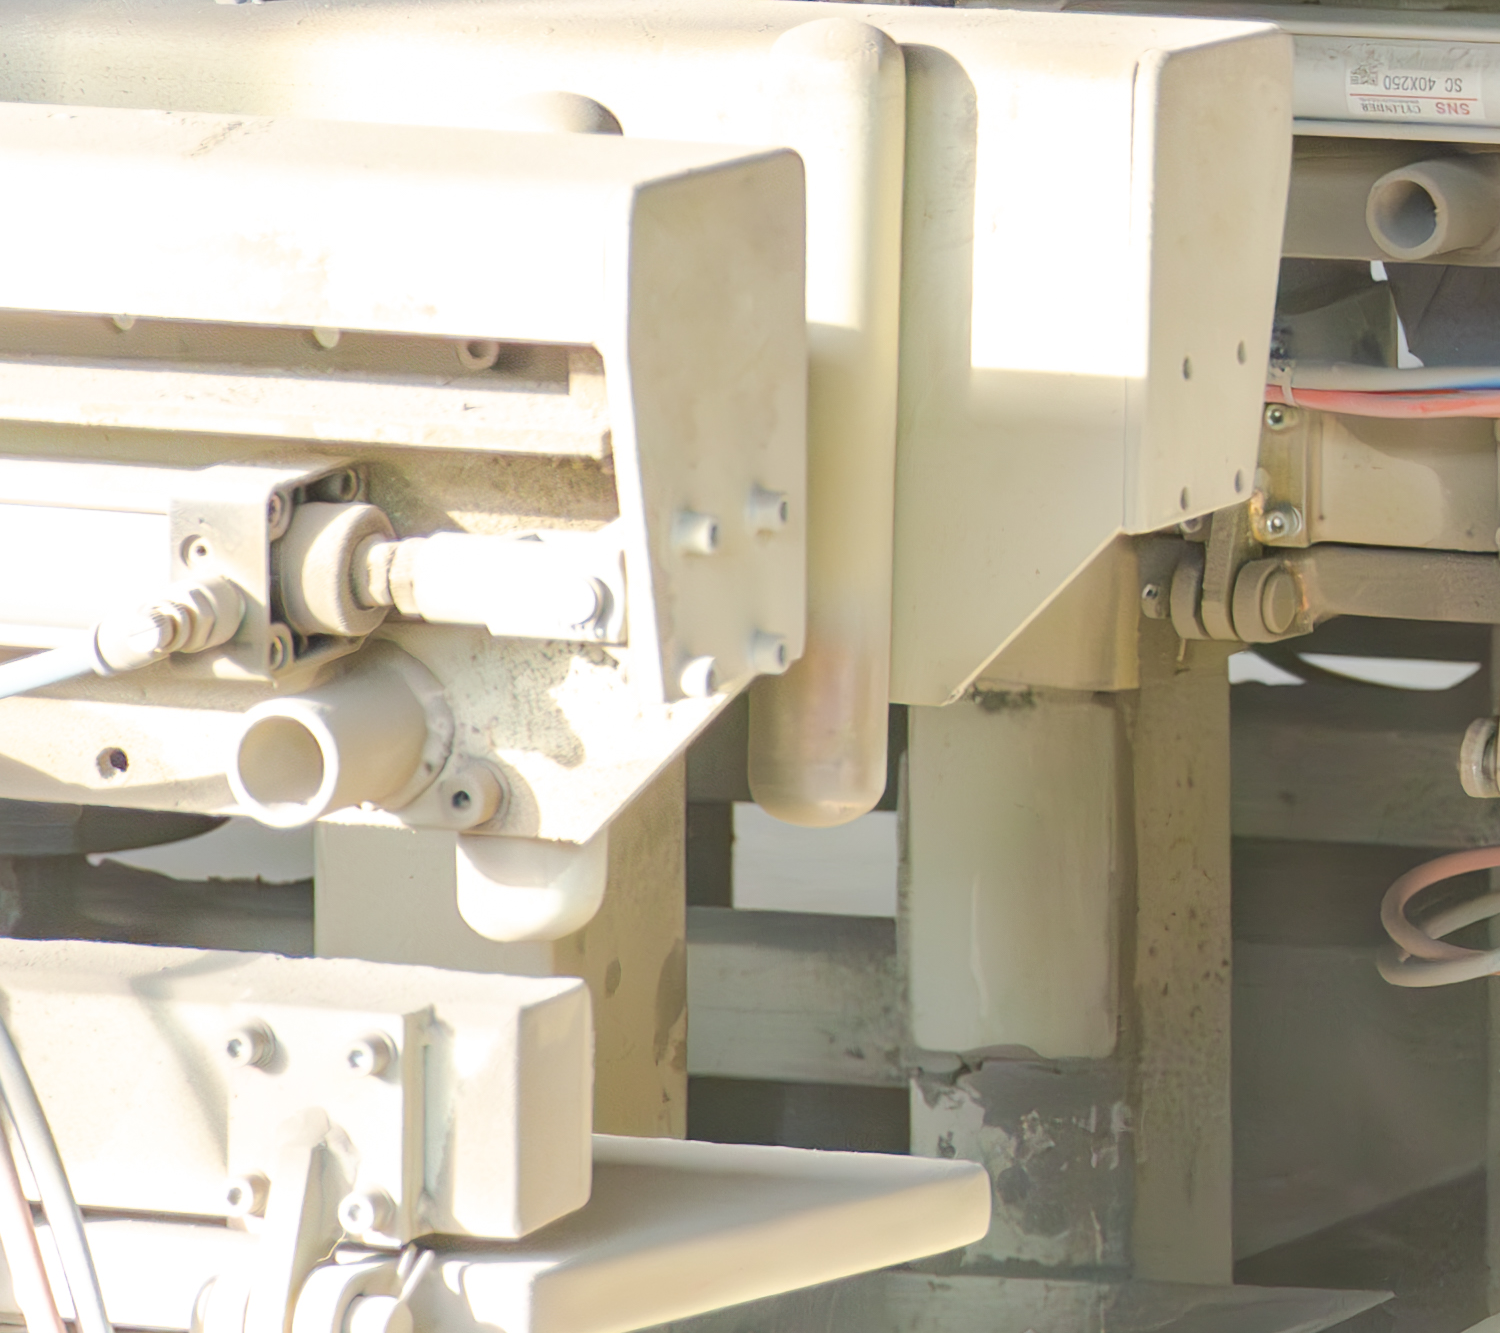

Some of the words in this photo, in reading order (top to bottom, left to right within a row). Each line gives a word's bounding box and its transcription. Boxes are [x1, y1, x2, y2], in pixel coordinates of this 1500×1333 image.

[1445, 77, 1463, 93] SC
[1361, 102, 1422, 114] CYLINDER
[1435, 101, 1471, 115] SNS
